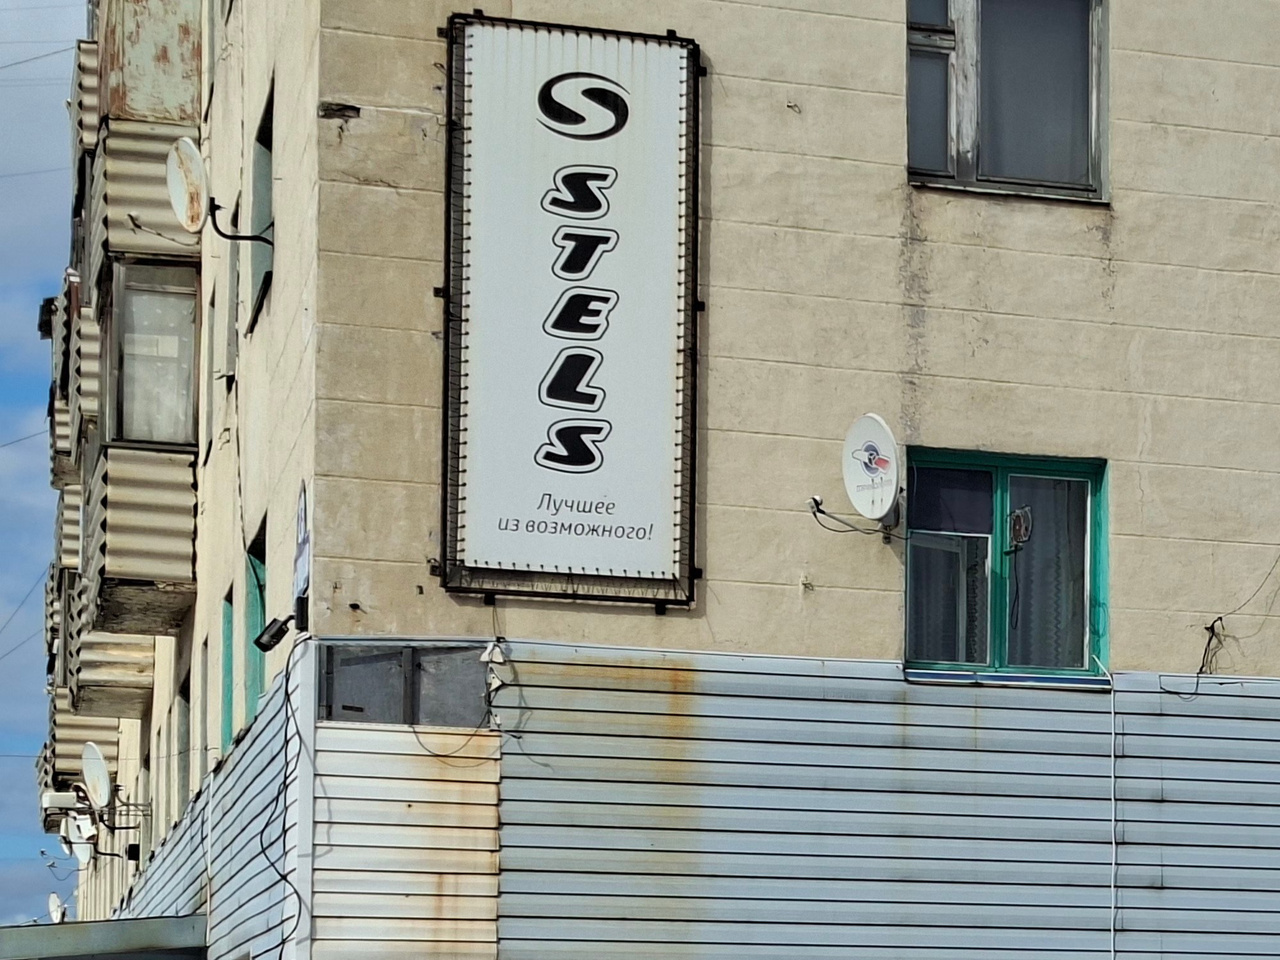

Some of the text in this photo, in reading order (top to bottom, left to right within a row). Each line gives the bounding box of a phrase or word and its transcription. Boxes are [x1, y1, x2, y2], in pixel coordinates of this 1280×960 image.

[534, 164, 619, 475] STELS
[536, 493, 616, 516] Лучшее
[497, 517, 654, 541] из возможного!
